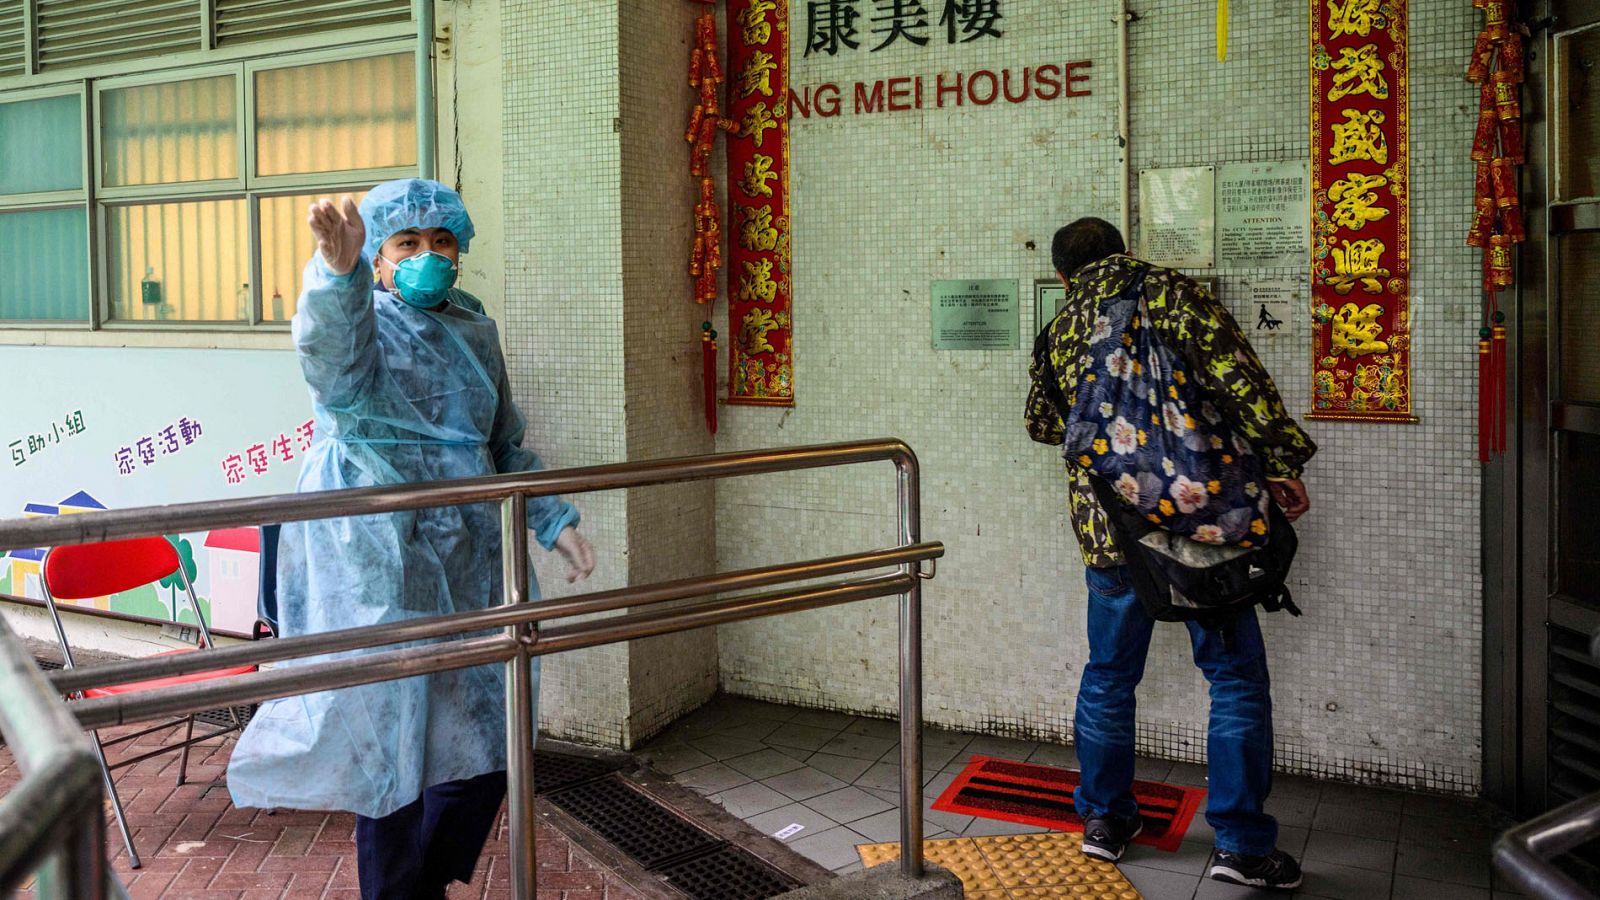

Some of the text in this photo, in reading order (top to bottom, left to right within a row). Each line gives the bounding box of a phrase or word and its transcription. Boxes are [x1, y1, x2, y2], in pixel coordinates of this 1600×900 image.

[803, 0, 1003, 58] 康美樓
[786, 60, 1093, 120] NG MEI HOUSE
[737, 0, 780, 356] 富貴平安福滿堂
[8, 410, 87, 467] 互助小組
[114, 417, 203, 475] 家庭活動
